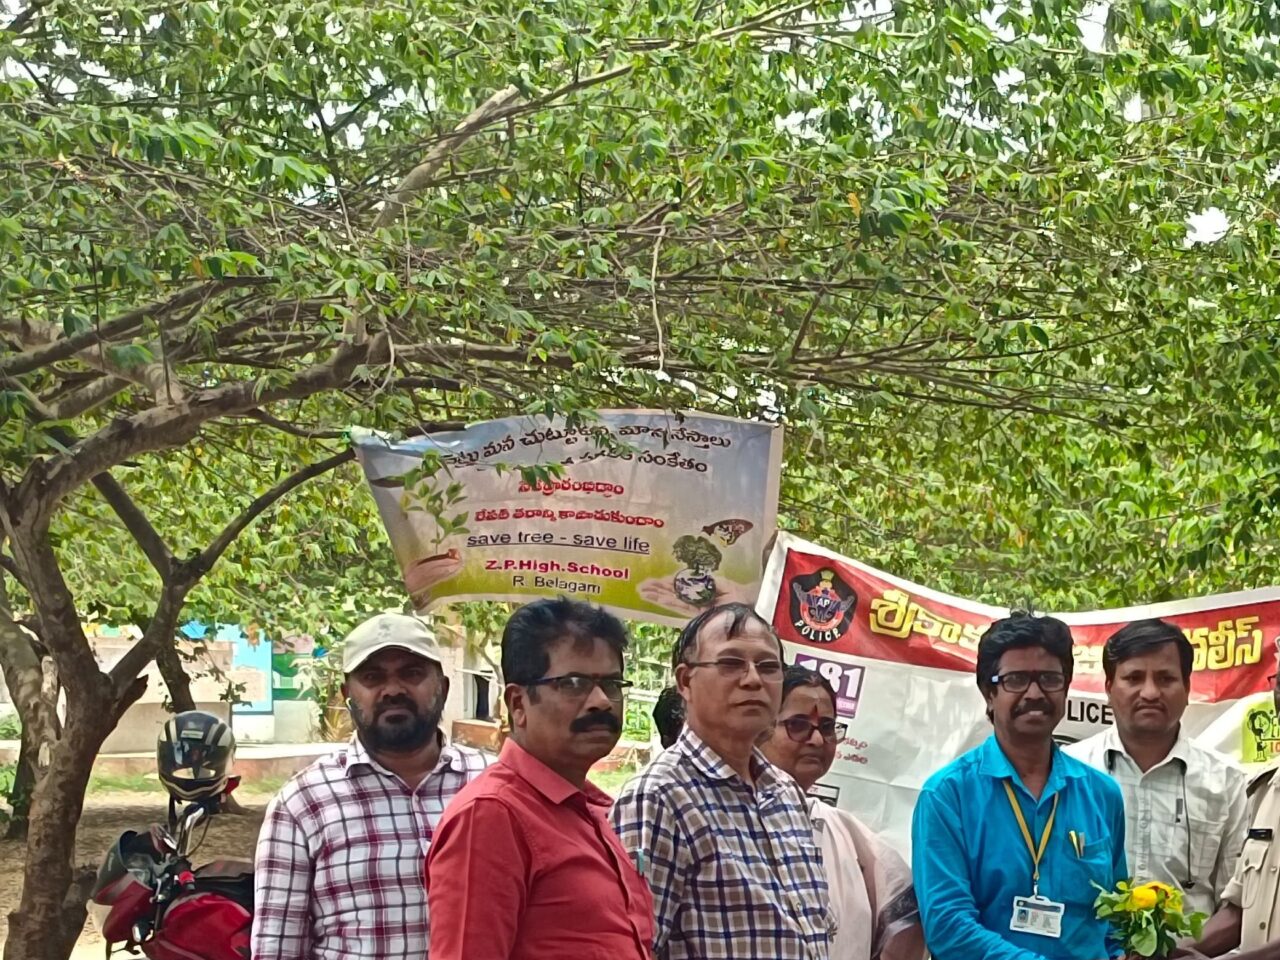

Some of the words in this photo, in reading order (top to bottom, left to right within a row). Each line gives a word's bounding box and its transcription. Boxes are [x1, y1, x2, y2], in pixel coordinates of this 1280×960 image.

[484, 435, 515, 458] మన
[638, 449, 708, 473] సంకేతం
[467, 532, 511, 547] save
[518, 531, 554, 544] tree
[573, 533, 617, 550] save
[624, 536, 650, 553] life
[534, 575, 601, 595] Belagam
[1066, 699, 1114, 726] LICE
